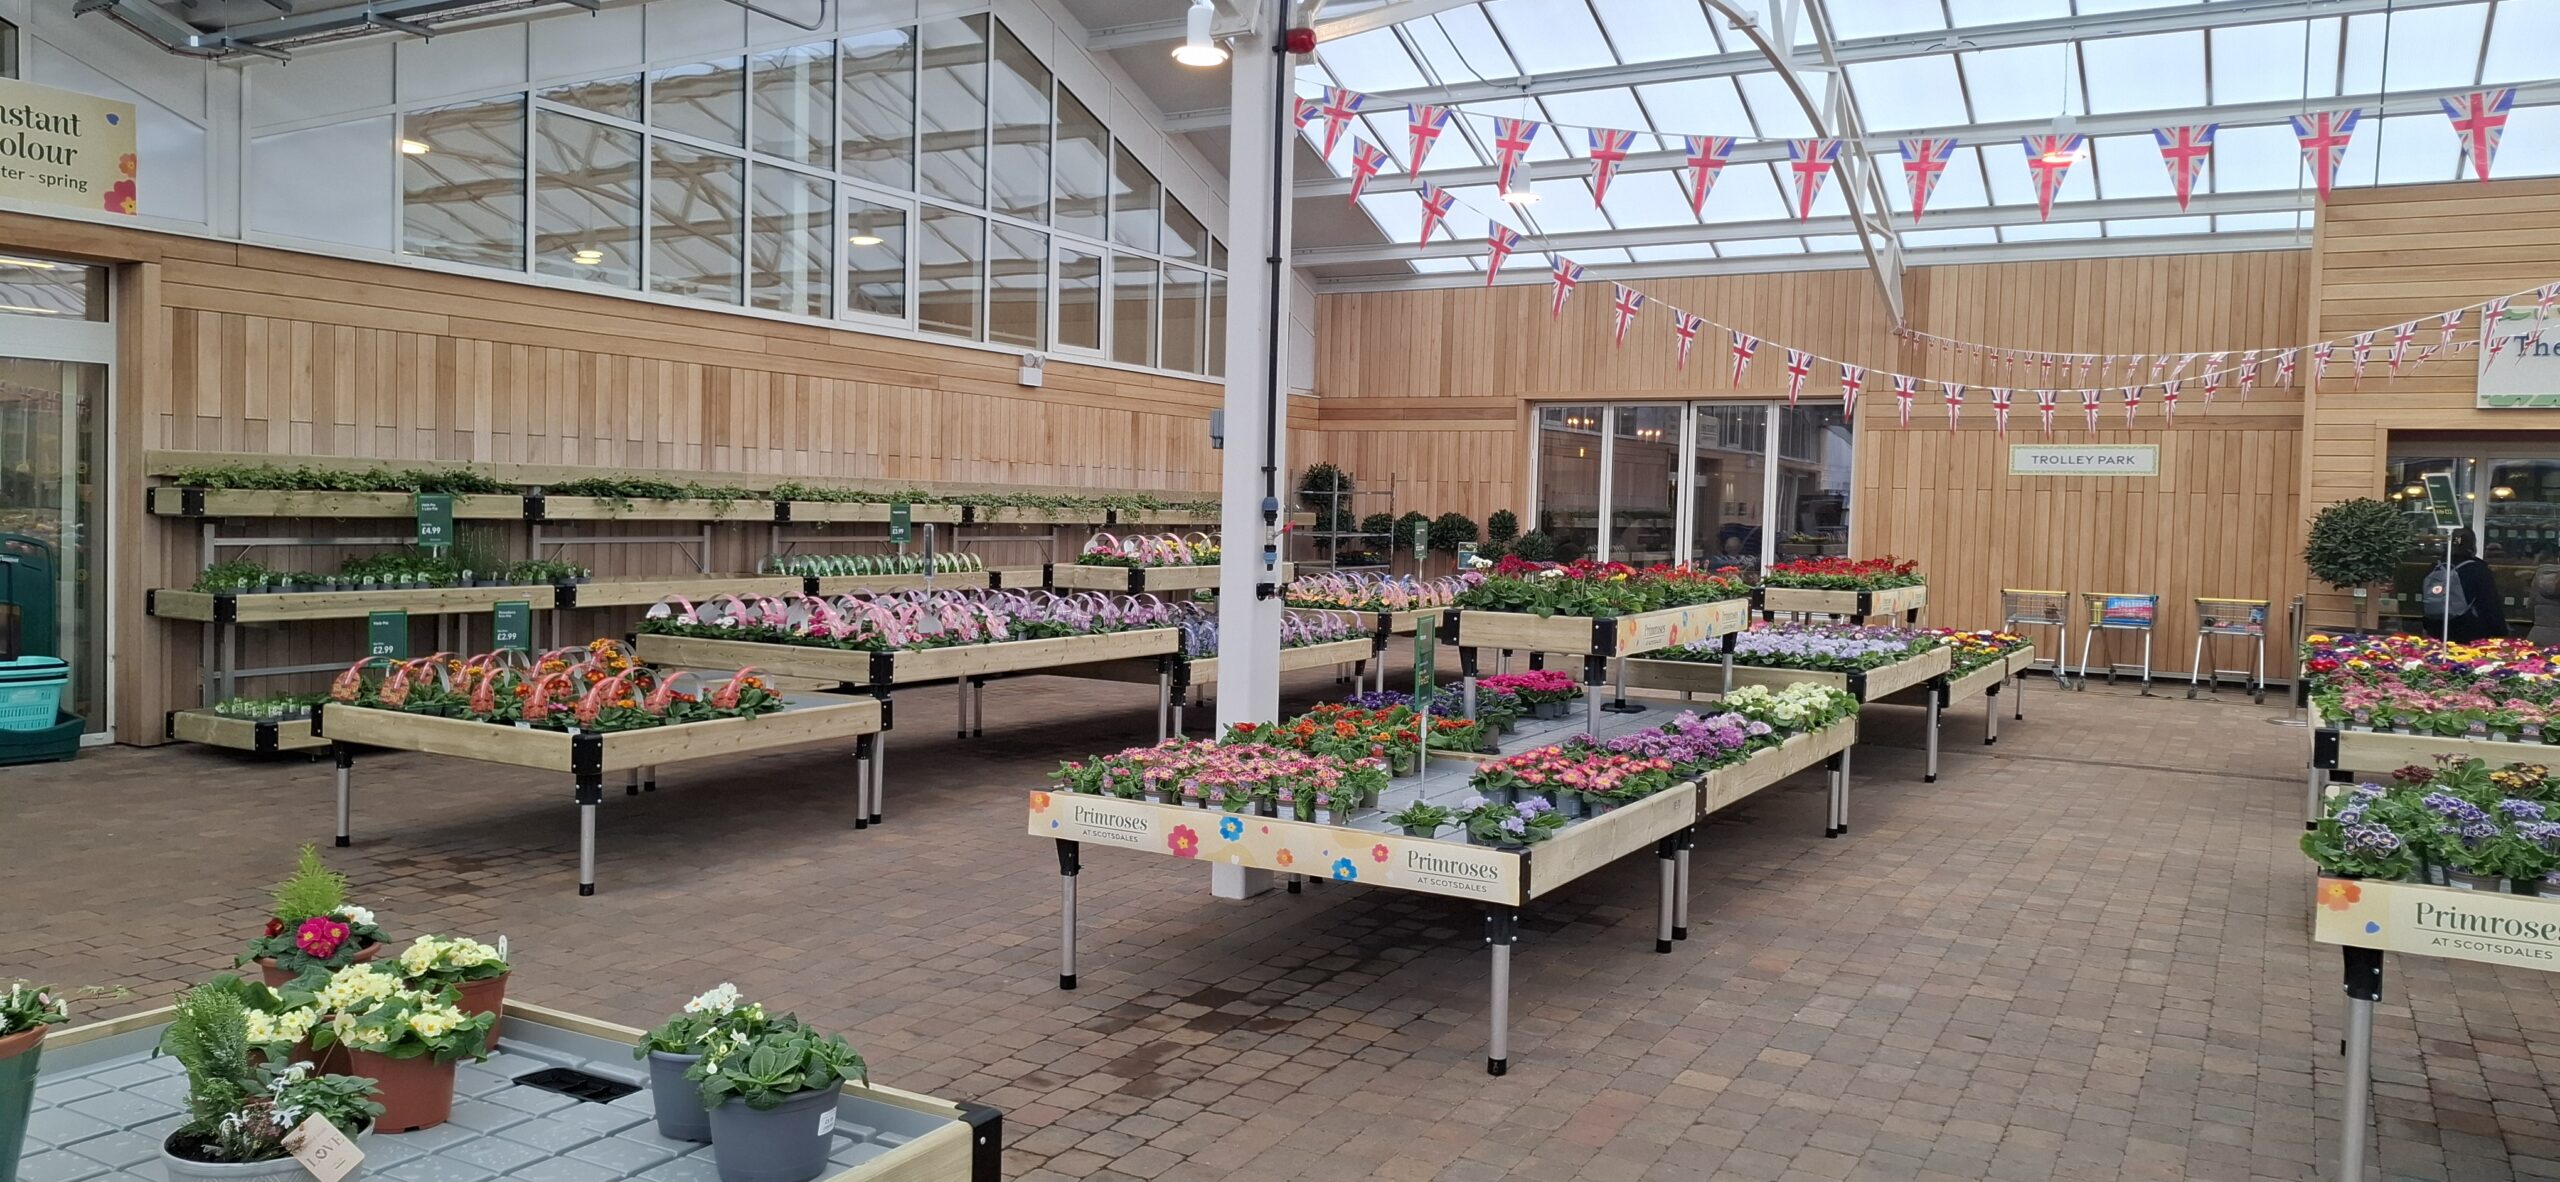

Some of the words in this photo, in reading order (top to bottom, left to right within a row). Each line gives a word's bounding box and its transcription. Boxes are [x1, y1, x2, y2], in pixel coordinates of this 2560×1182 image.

[38, 173, 88, 193] spring
[2031, 455, 2094, 465] TROLLEY
[2097, 455, 2136, 465] PARK
[421, 526, 441, 535] £4.99
[497, 632, 517, 641] £2.99
[373, 645, 394, 655] £2.99
[1075, 805, 1149, 832] Primroses
[1092, 830, 1139, 843] SCOTSDALES
[1408, 849, 1499, 880] Primroses
[1417, 876, 1429, 884] AT
[1430, 878, 1487, 893] SCOTSDALES
[2432, 937, 2449, 946] AT
[2454, 939, 2553, 960] SCOTSDALES
